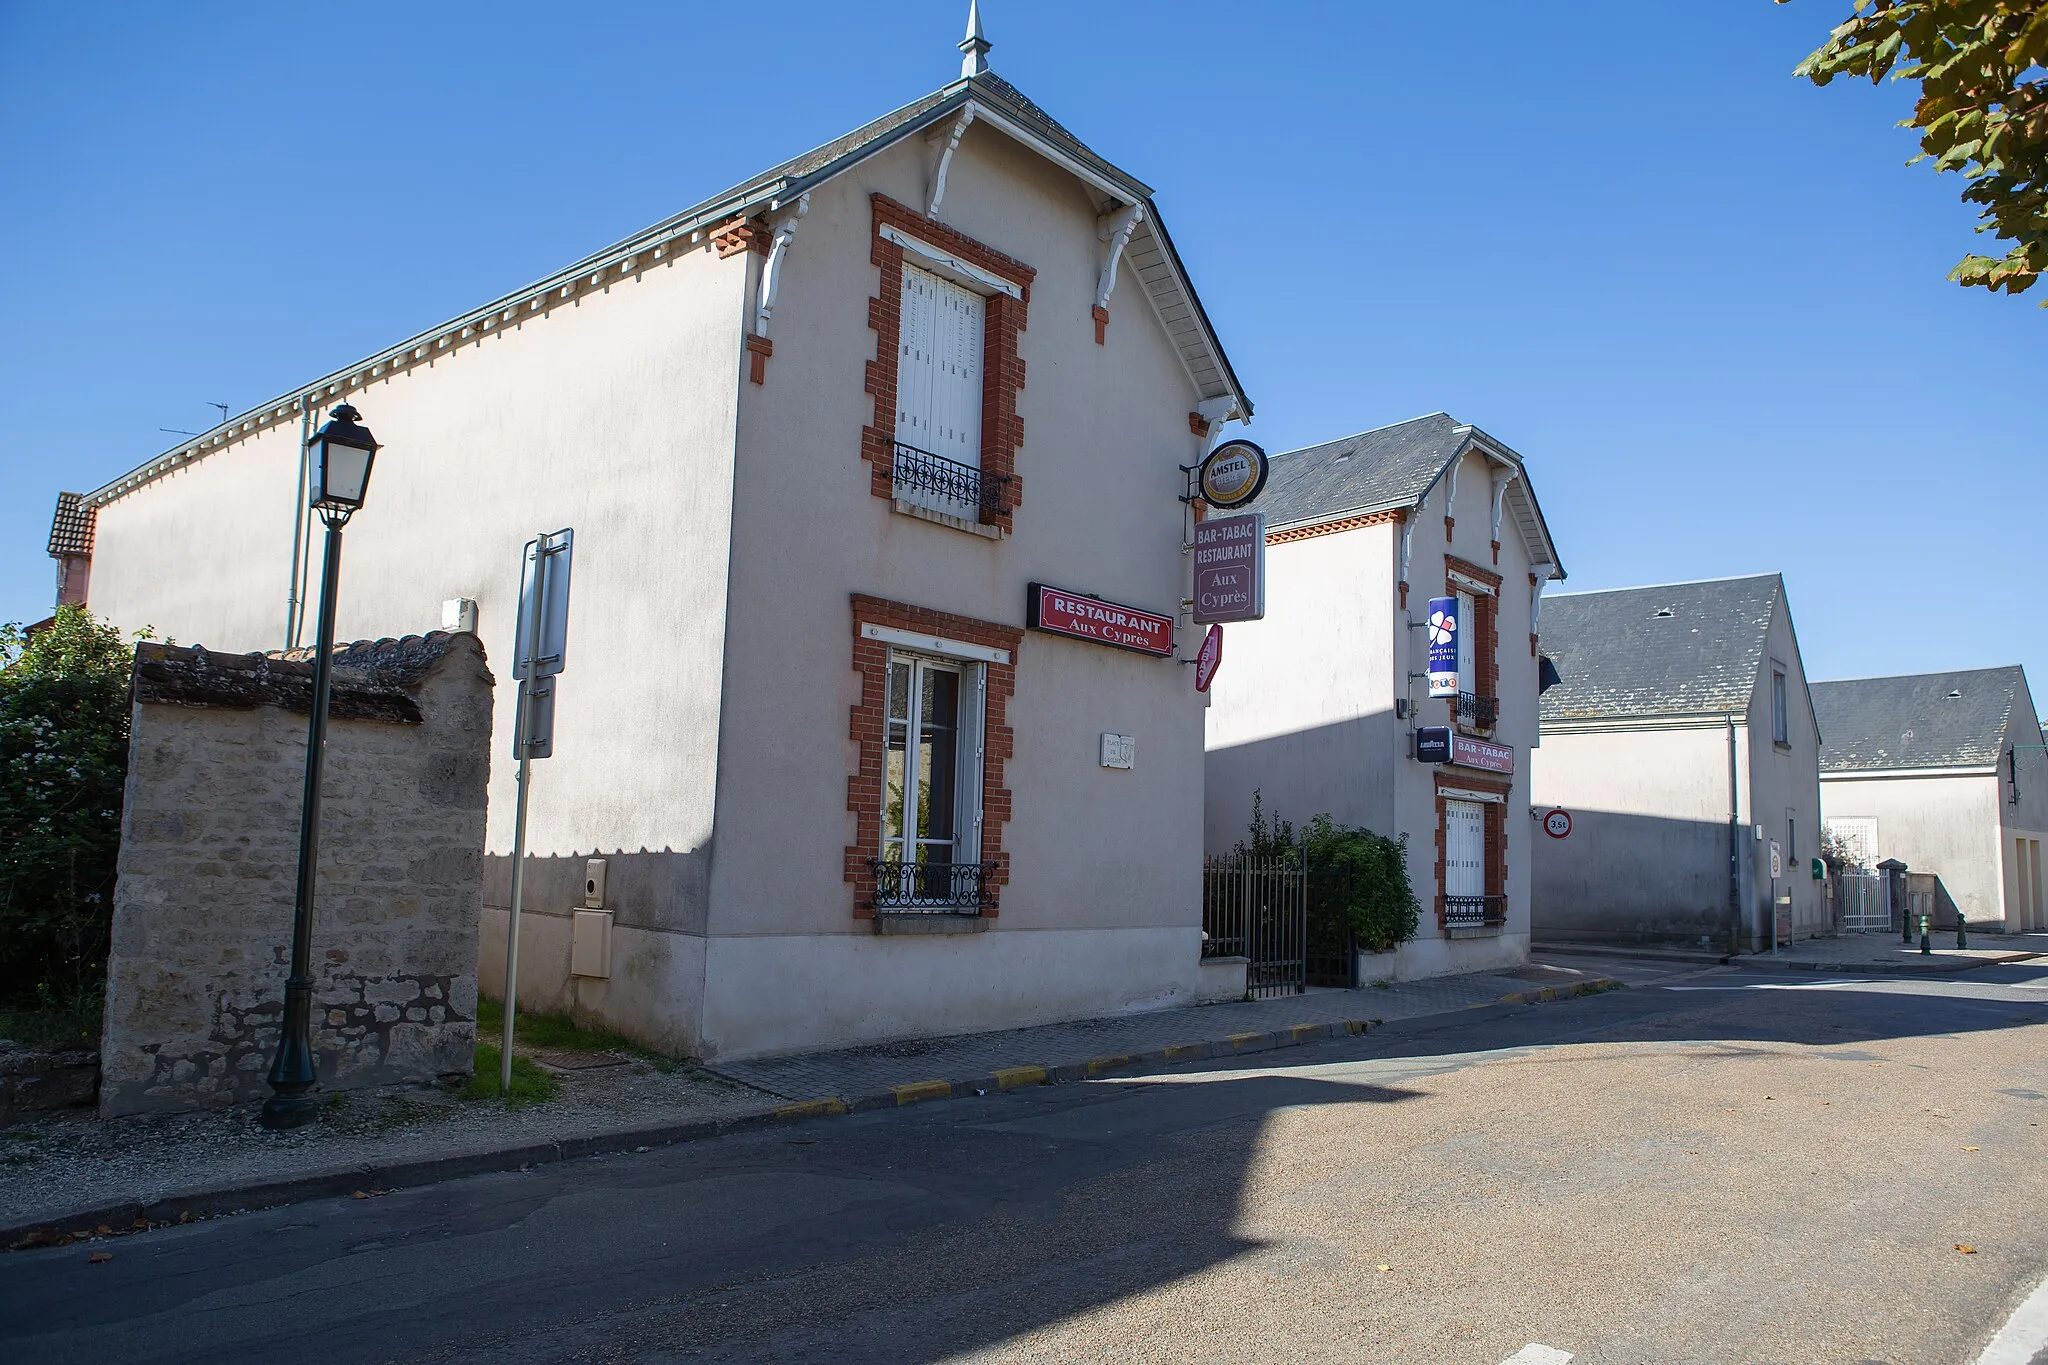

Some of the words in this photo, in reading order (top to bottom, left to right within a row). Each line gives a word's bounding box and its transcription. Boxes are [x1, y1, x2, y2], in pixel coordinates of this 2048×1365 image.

[1211, 460, 1246, 479] AMSTEL
[1198, 523, 1253, 544] BAR-TABAC
[1197, 544, 1252, 564] RESTAURANT
[1211, 573, 1237, 587] Aux
[1201, 589, 1247, 608] Cyprès
[1054, 598, 1161, 634] RESTAURANT
[1068, 618, 1097, 635] Aux
[1102, 626, 1149, 647] Cyprès
[1198, 636, 1214, 678] TABAC
[1465, 755, 1478, 765] Aux
[1480, 757, 1503, 769] Cyprès
